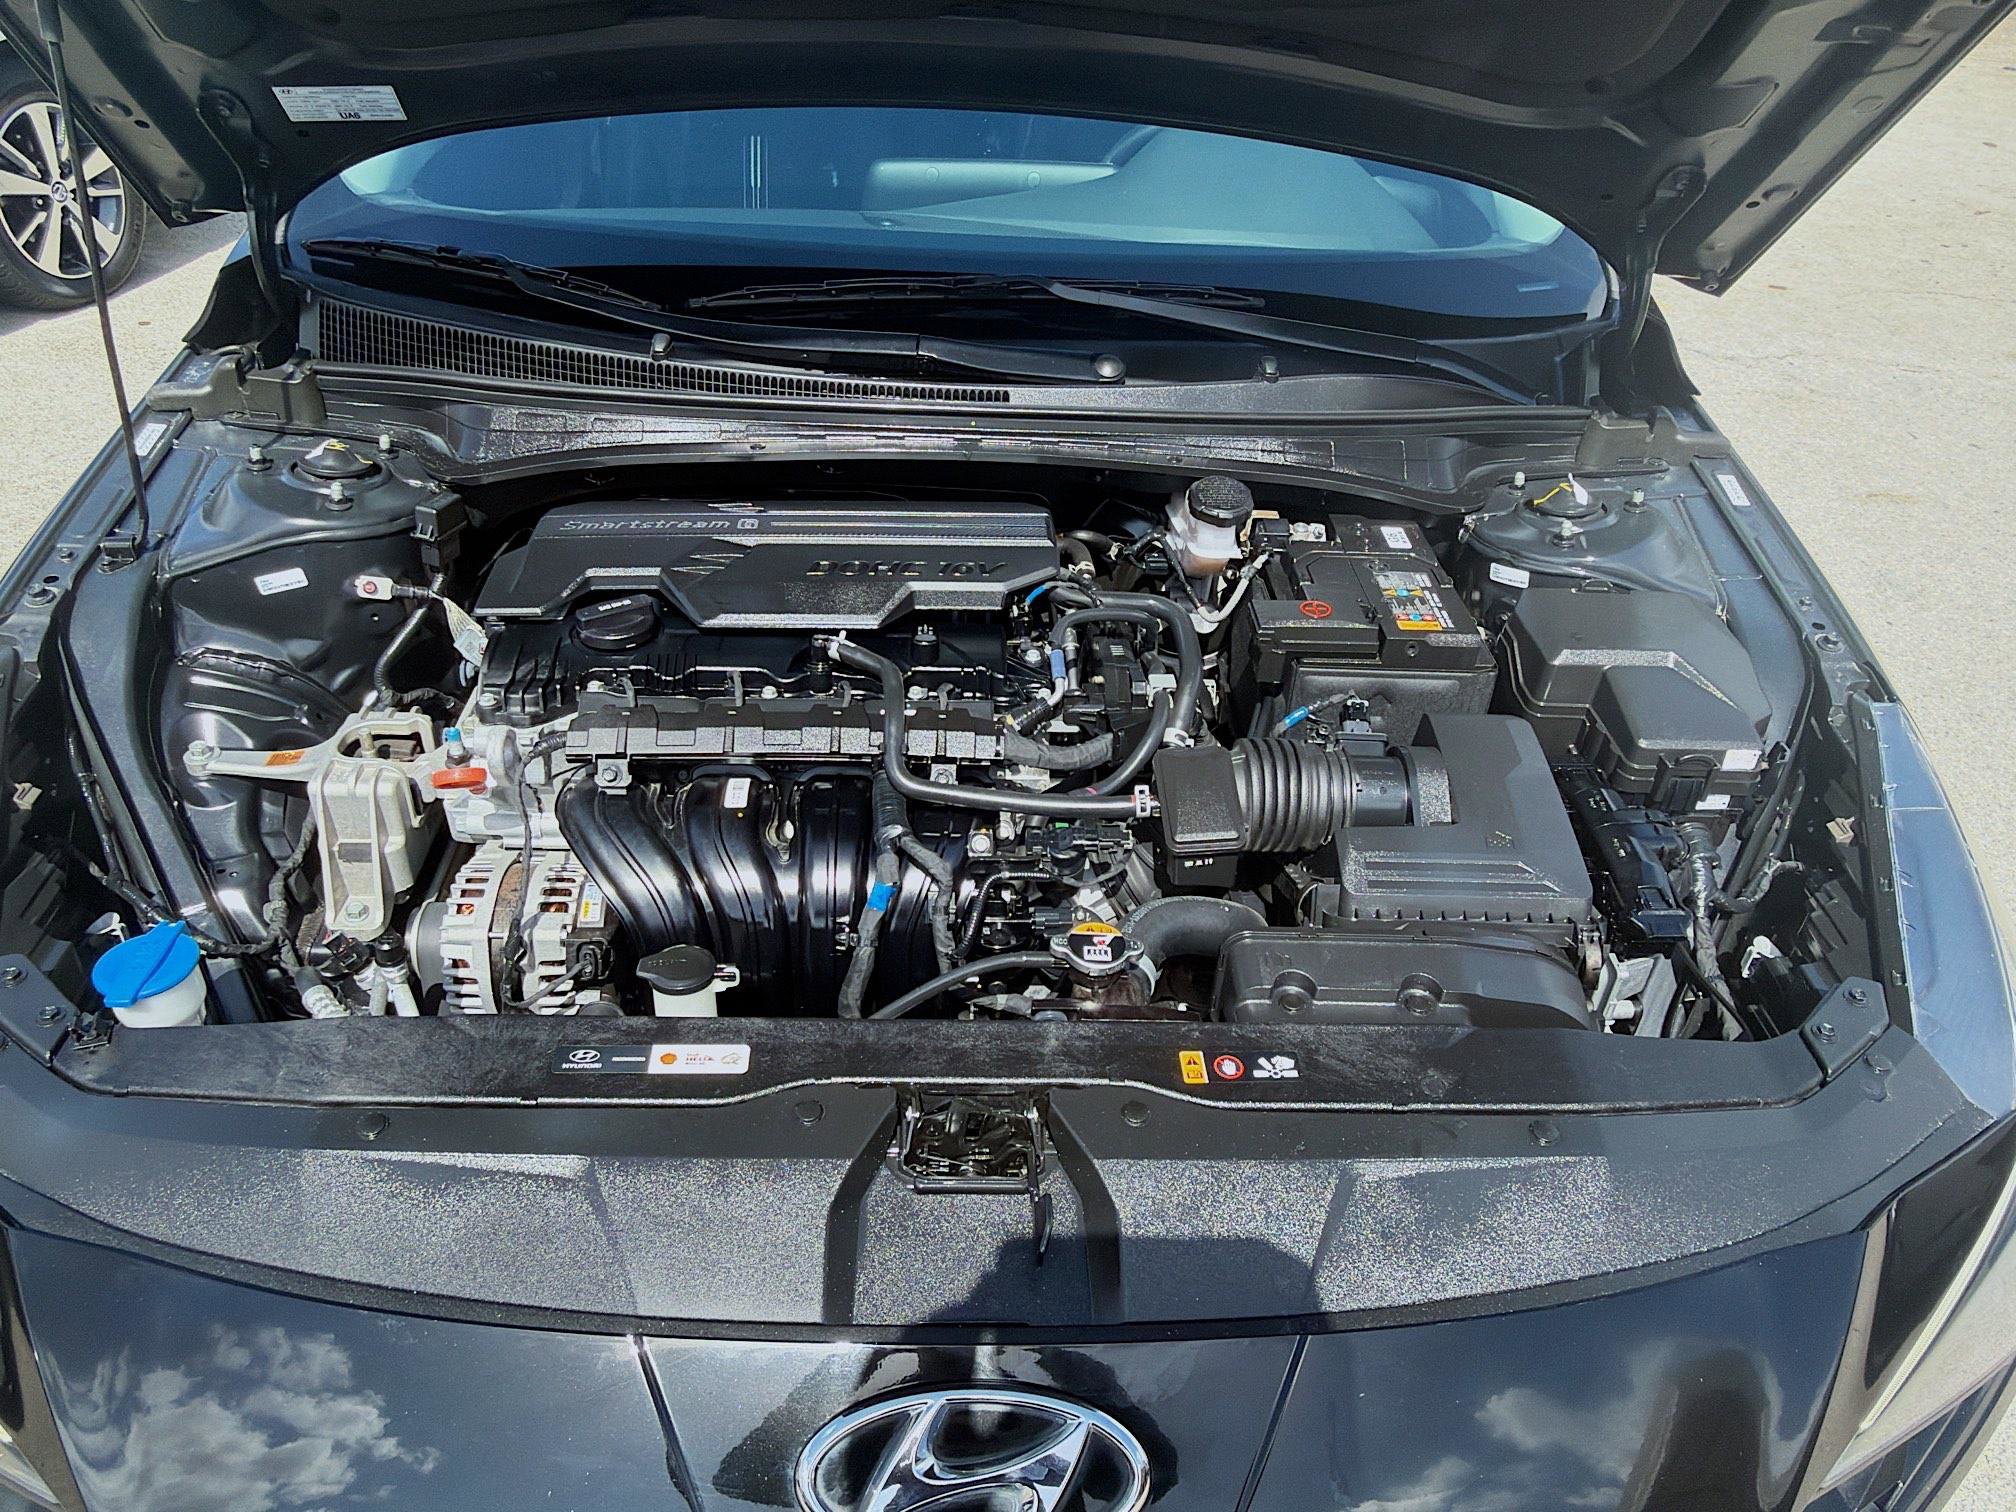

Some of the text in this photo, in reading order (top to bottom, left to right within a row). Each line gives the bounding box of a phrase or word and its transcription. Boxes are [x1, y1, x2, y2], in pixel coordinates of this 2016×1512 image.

[559, 519, 731, 531] Smartstream
[806, 560, 1008, 577] DOHC 16V
